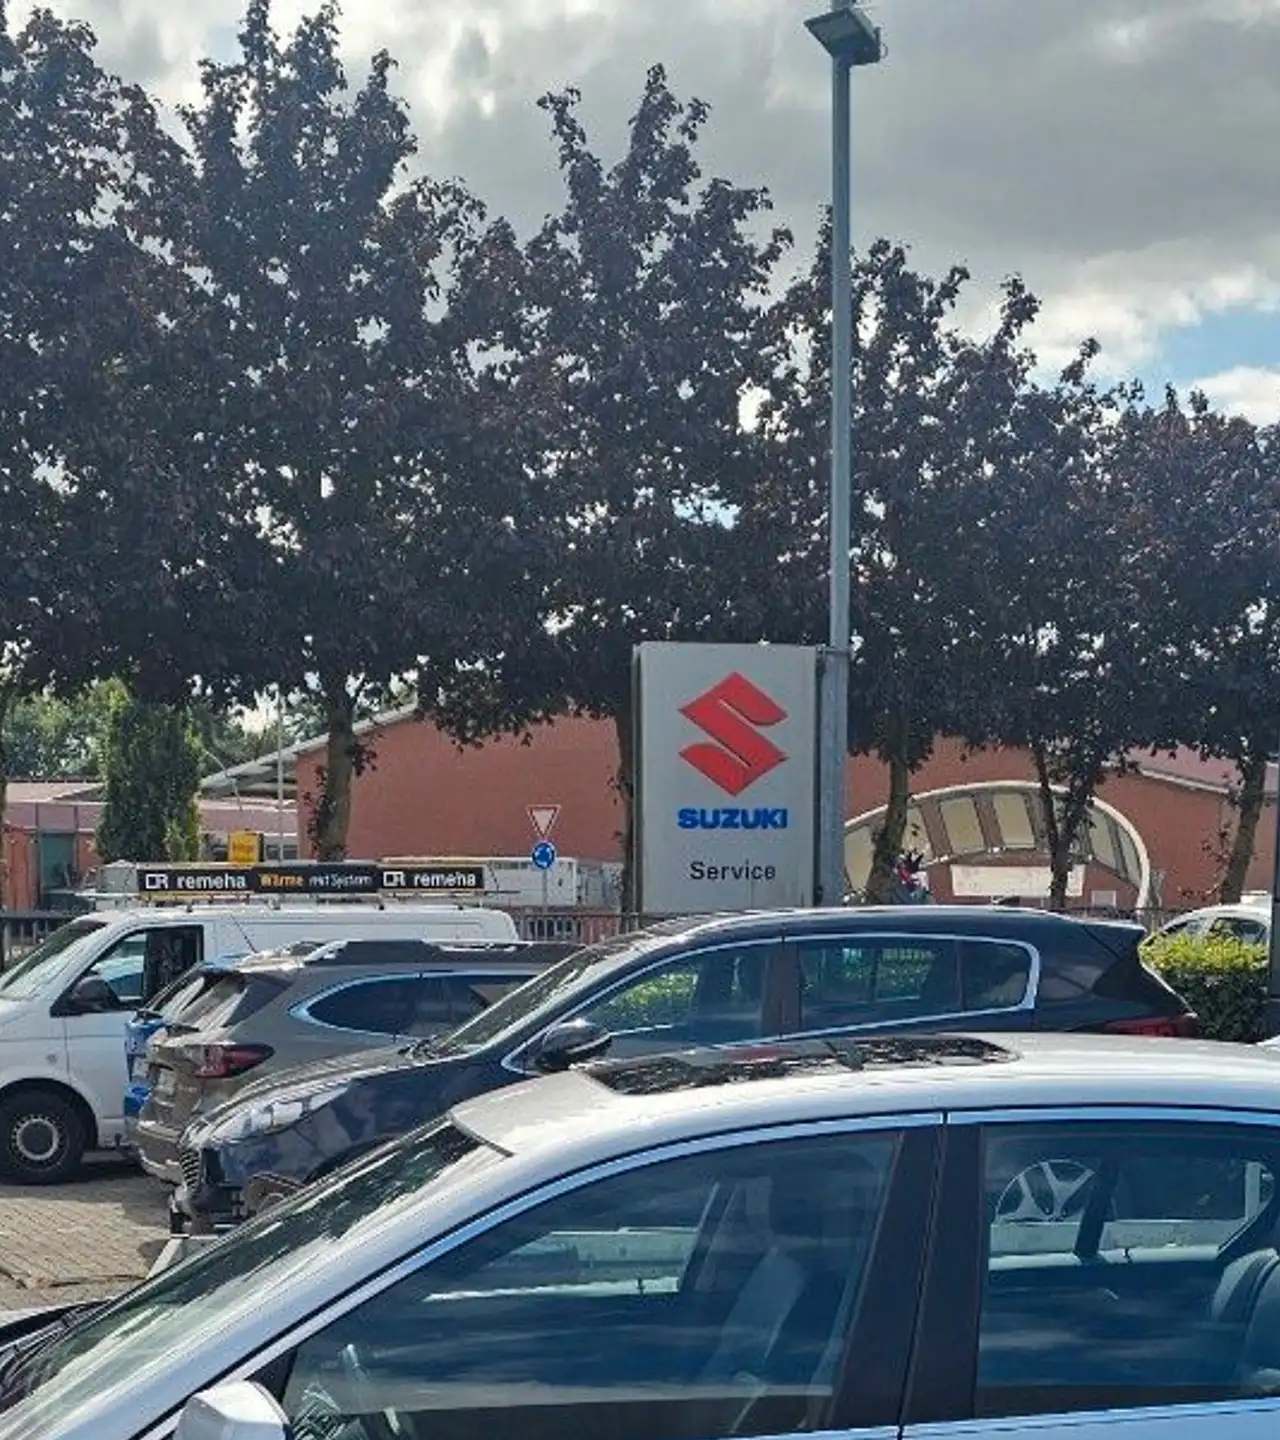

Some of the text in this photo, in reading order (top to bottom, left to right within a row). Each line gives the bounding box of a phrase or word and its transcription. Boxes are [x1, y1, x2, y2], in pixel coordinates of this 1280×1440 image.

[677, 808, 788, 829] SUZUKI
[176, 873, 247, 889] remeha
[414, 871, 476, 887] remeha
[690, 859, 776, 880] Service
